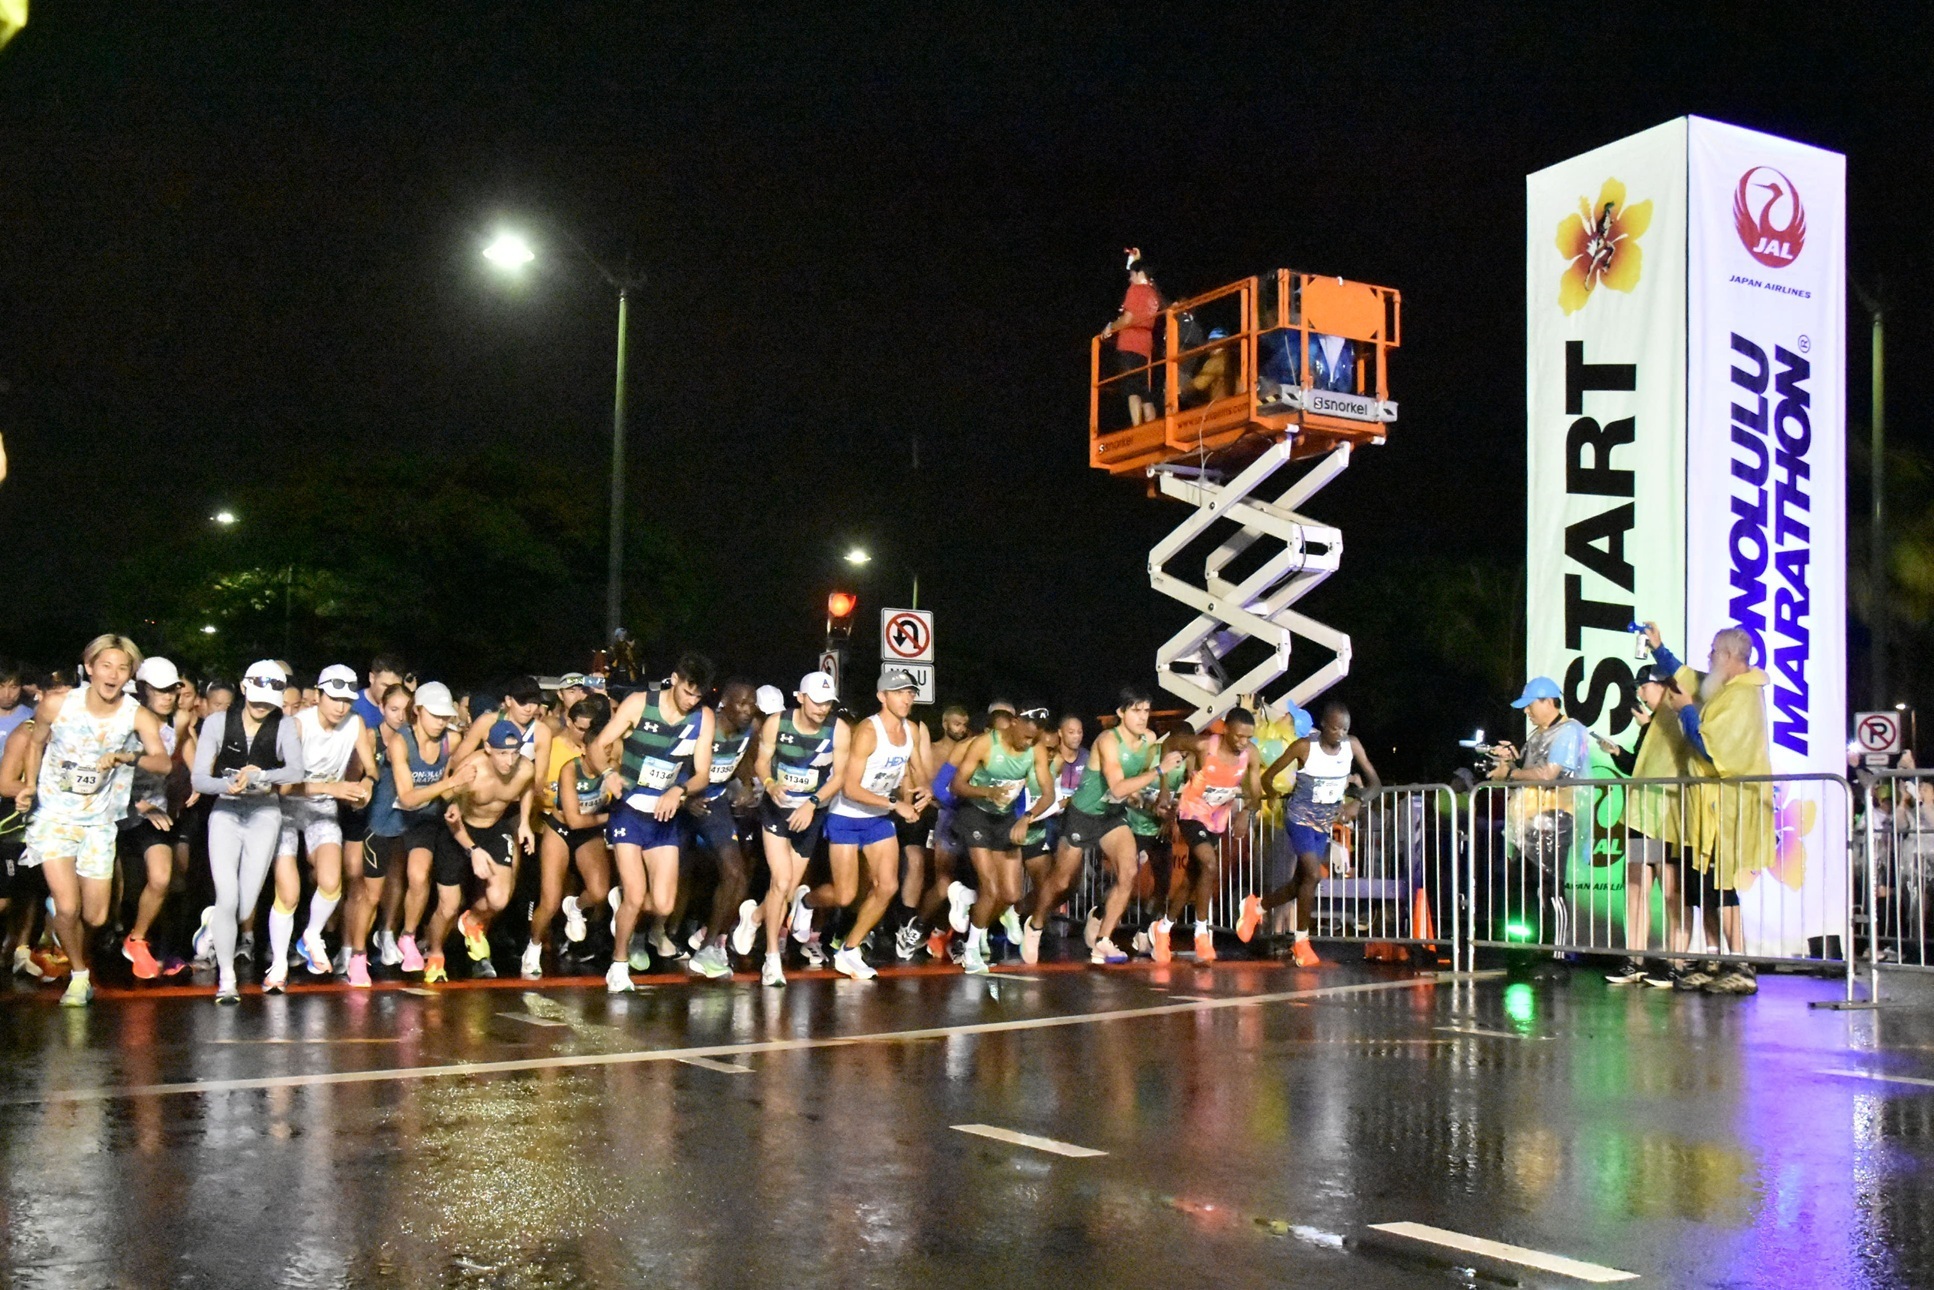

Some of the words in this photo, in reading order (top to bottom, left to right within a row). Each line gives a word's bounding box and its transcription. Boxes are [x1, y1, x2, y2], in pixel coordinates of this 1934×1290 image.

[1752, 236, 1794, 260] JAL
[1729, 274, 1763, 288] JAPAN
[1764, 282, 1812, 300] AIRLINES
[1324, 399, 1368, 416] snorkel
[1564, 341, 1637, 736] START
[710, 765, 735, 775] 41350
[76, 775, 97, 785] 743
[783, 774, 810, 785] 41349
[1592, 838, 1624, 856] AL
